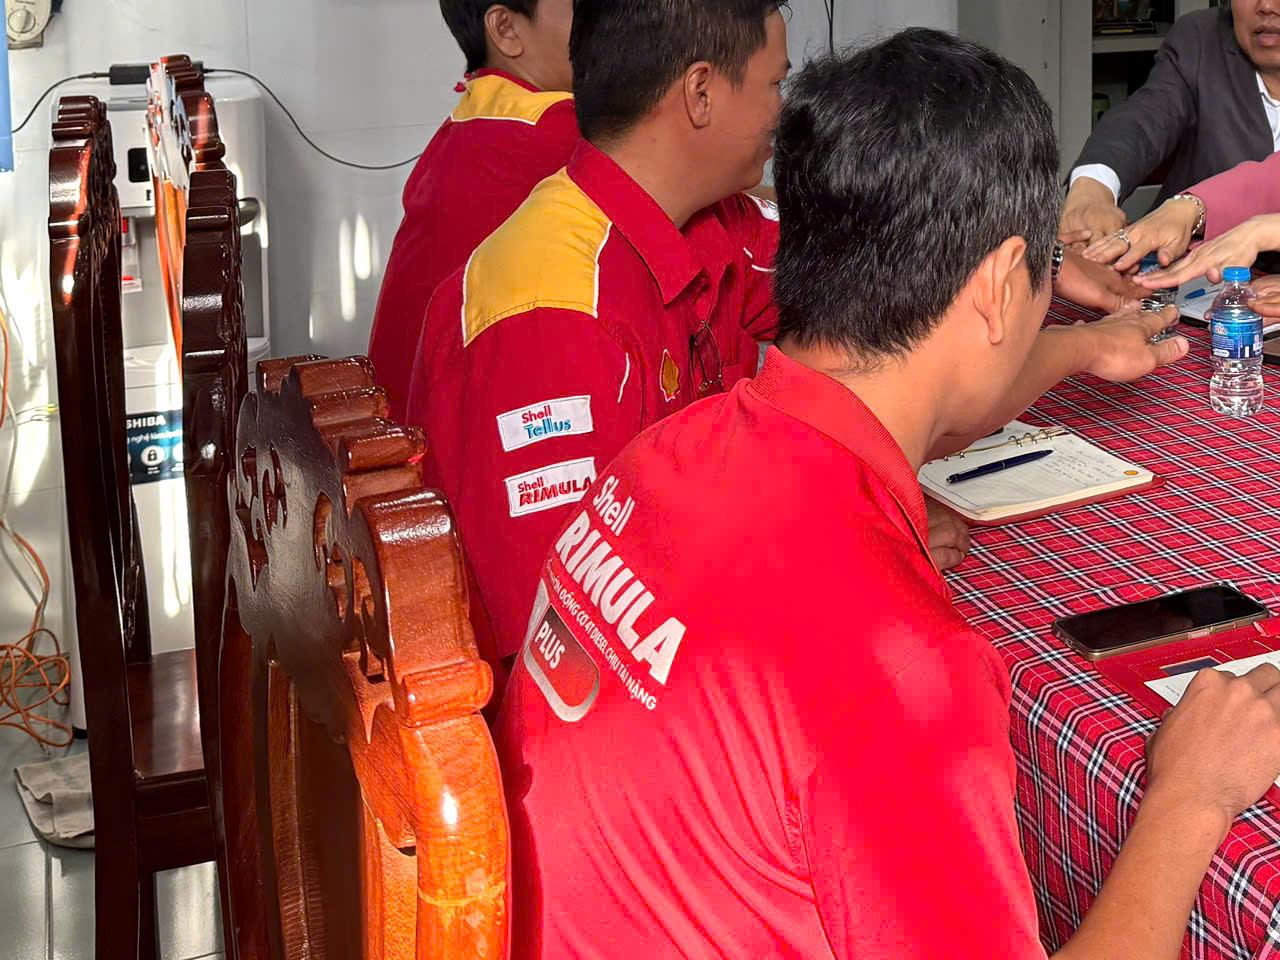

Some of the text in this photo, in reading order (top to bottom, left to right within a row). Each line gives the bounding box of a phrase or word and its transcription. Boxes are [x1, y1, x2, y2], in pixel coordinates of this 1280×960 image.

[126, 414, 167, 430] SHIBA
[521, 404, 553, 425] Shell
[523, 417, 572, 440] Tellus
[517, 476, 544, 494] Shell
[519, 476, 592, 507] RIMULA
[592, 475, 636, 537] Shell
[555, 510, 687, 685] RIMULA
[534, 620, 566, 669] PLUS
[589, 627, 609, 655] DIESEL
[625, 676, 657, 711] NẶNG
